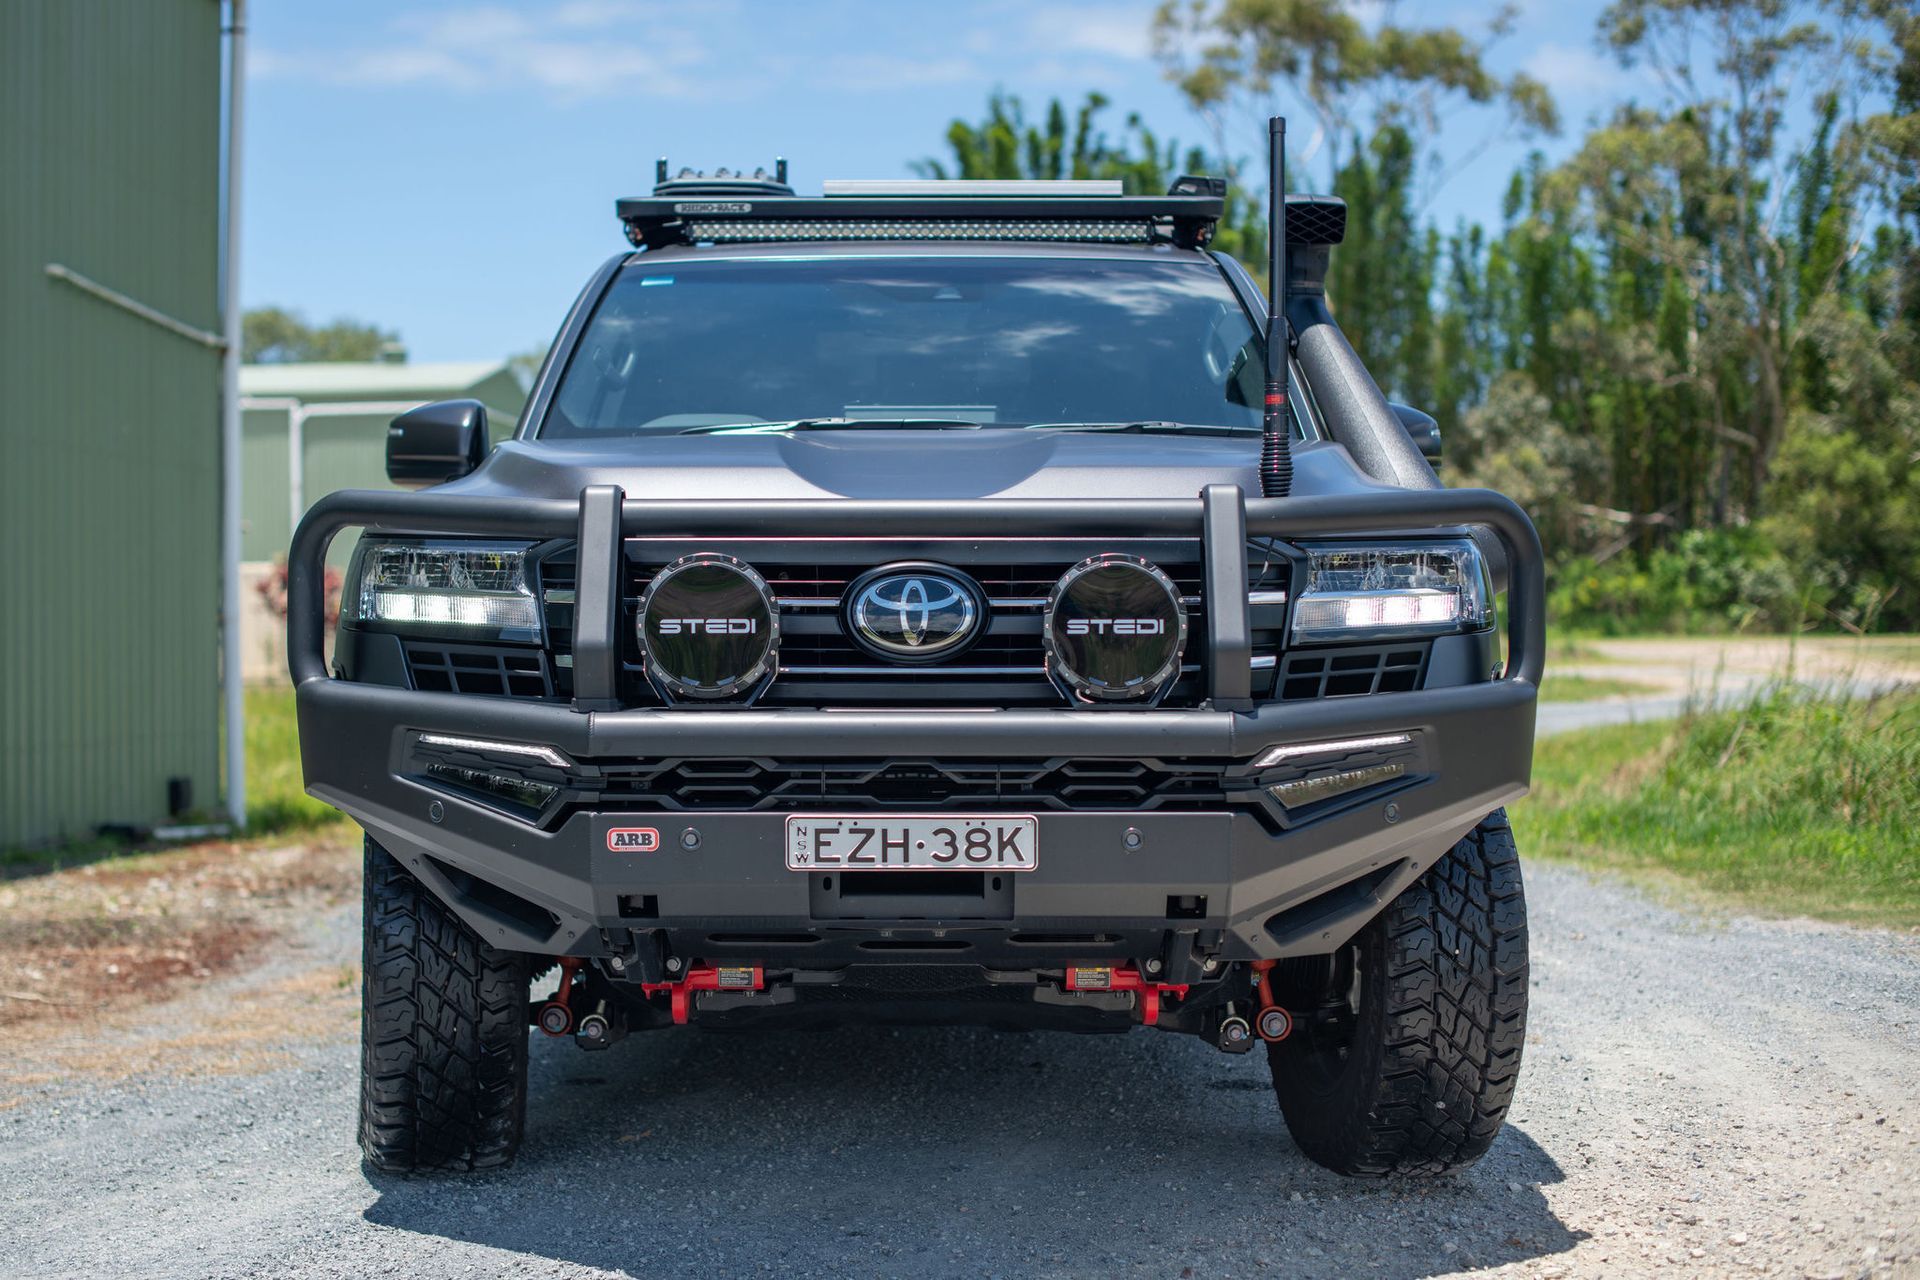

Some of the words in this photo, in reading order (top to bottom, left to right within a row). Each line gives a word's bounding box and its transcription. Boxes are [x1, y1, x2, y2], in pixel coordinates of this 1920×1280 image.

[660, 619, 756, 634] STEDI
[1067, 619, 1164, 634] STEDI
[614, 833, 653, 846] ARB
